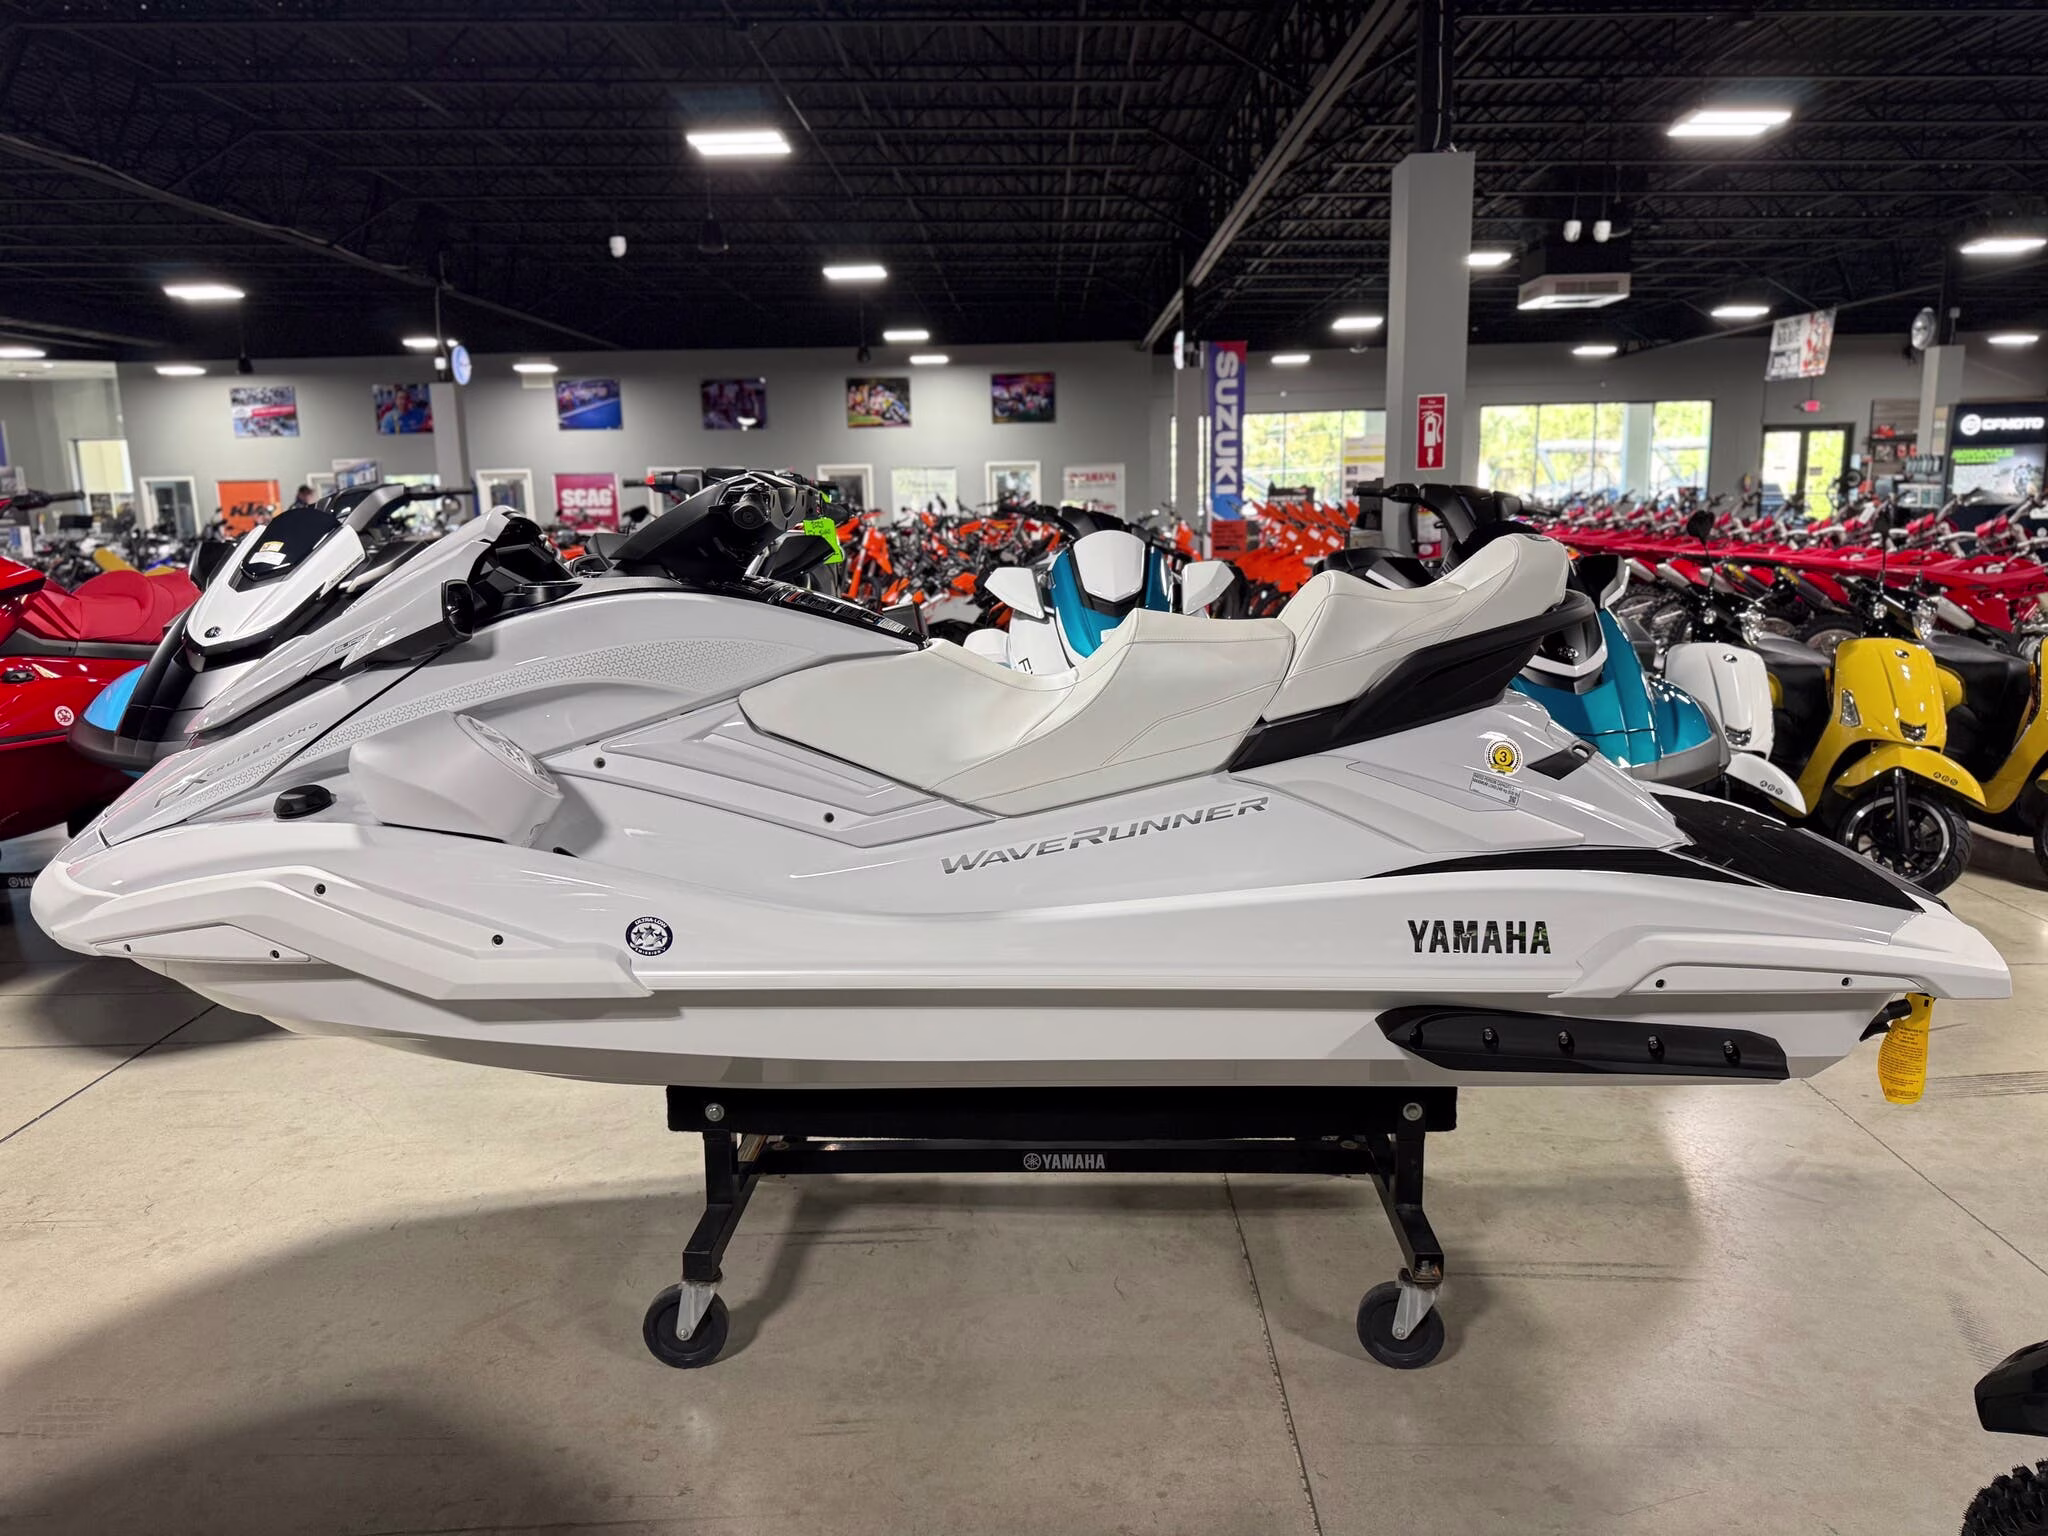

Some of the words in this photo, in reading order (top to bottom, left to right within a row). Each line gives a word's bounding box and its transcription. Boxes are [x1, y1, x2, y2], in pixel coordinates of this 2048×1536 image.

[1214, 350, 1240, 495] SUZUKI
[1982, 417, 2045, 431] CFMOTO
[561, 488, 613, 507] SCAG
[1499, 751, 1507, 763] 3
[940, 796, 1269, 874] WAVERUNNER
[1407, 920, 1551, 954] YAMAHA
[1041, 1153, 1106, 1170] YAMAHA
